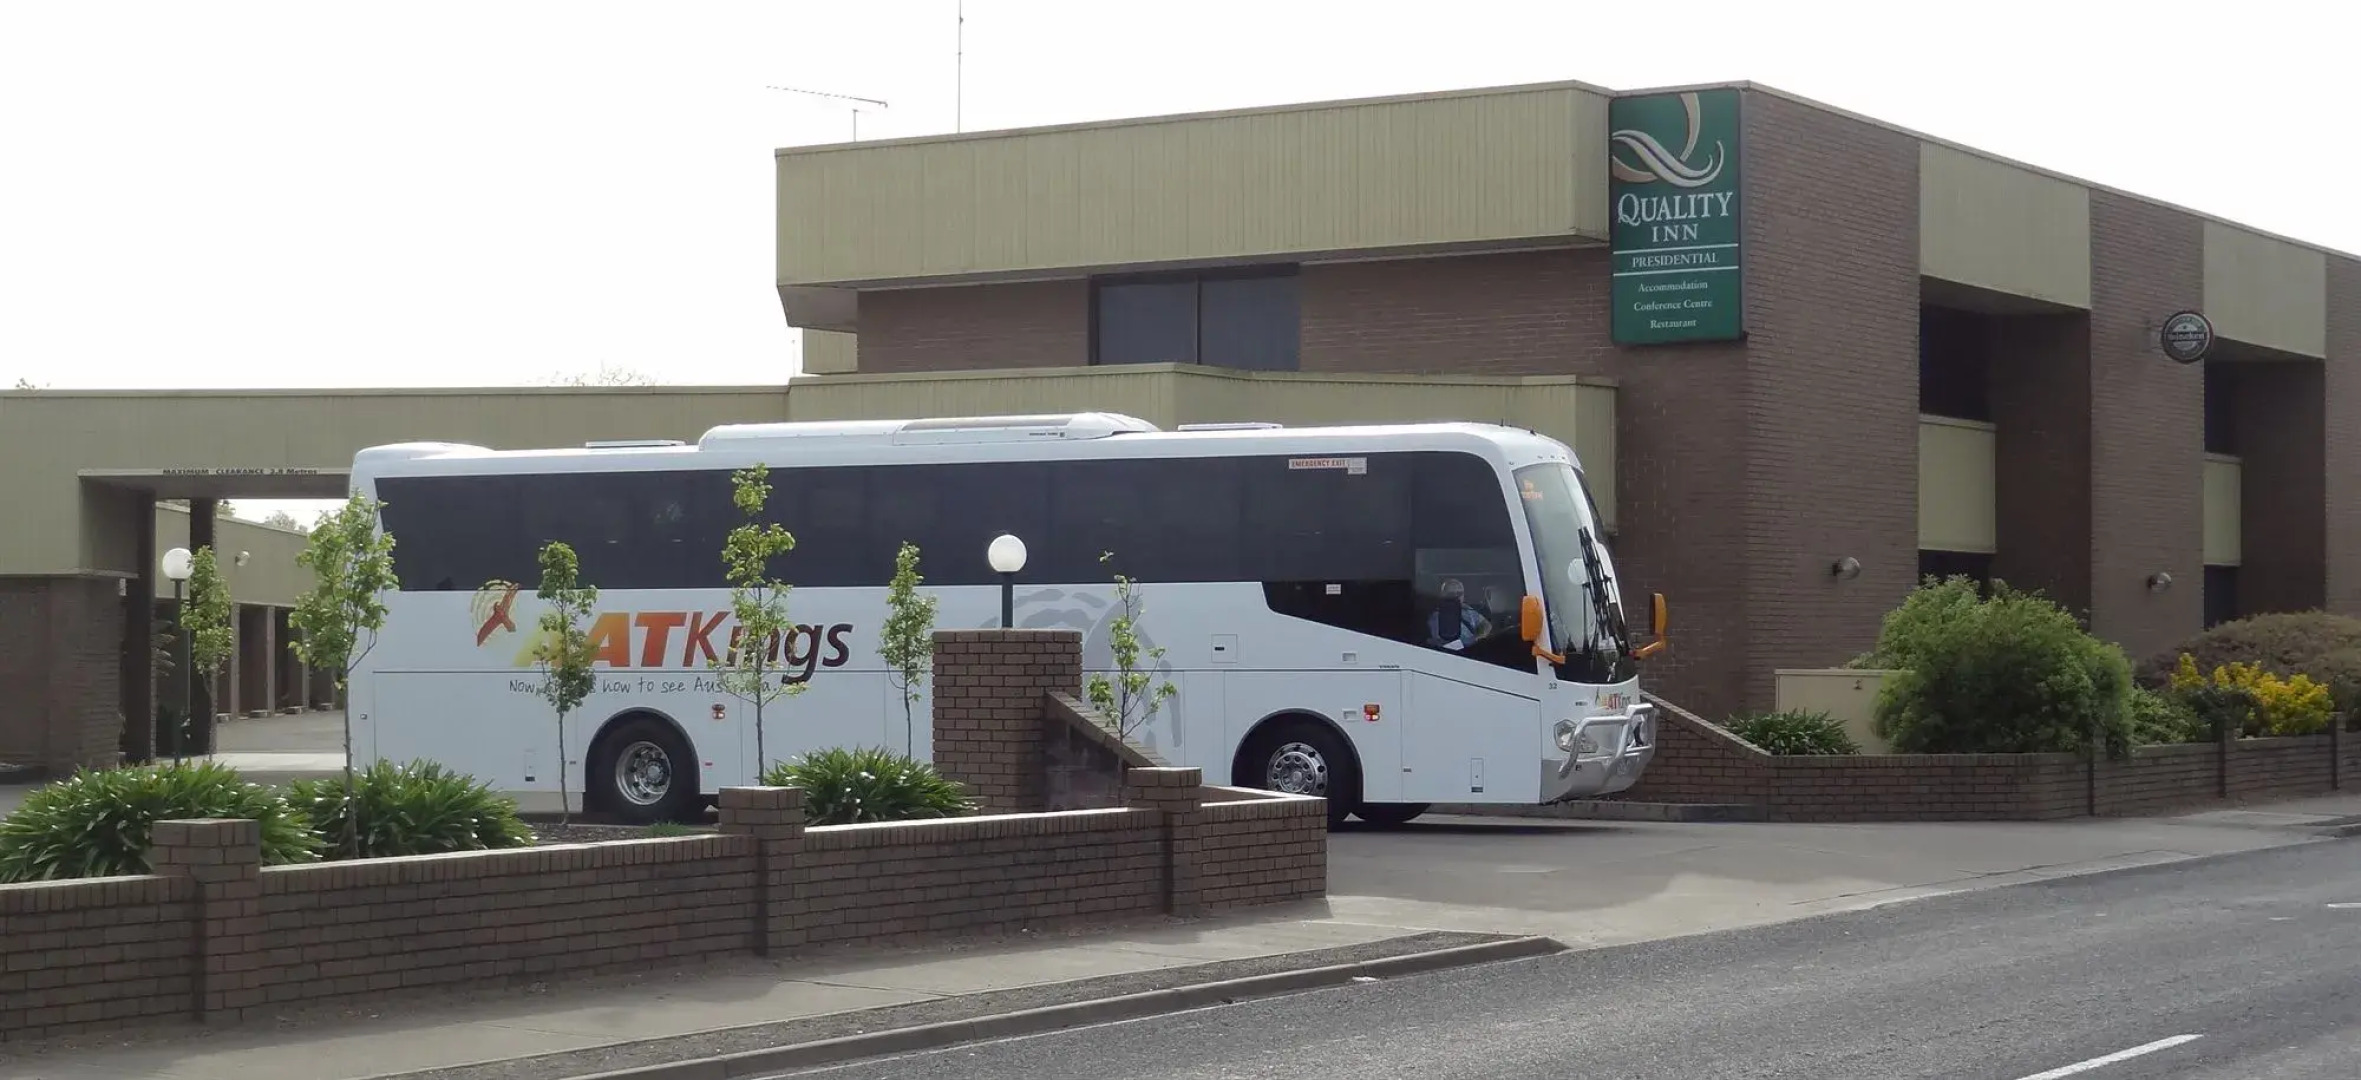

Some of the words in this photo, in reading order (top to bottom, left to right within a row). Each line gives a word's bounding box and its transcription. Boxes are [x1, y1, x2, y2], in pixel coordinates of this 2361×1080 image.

[1617, 191, 1734, 227] QUALITY
[1652, 223, 1699, 243] INN
[1632, 252, 1719, 269] PRESIDENTIAL
[1638, 280, 1708, 293] Accommodation
[1633, 301, 1682, 312] Conference
[1683, 299, 1713, 309] Centre
[1650, 319, 1697, 329] Restaurant
[602, 679, 632, 694] how
[638, 676, 655, 693] to
[660, 680, 686, 694] see
